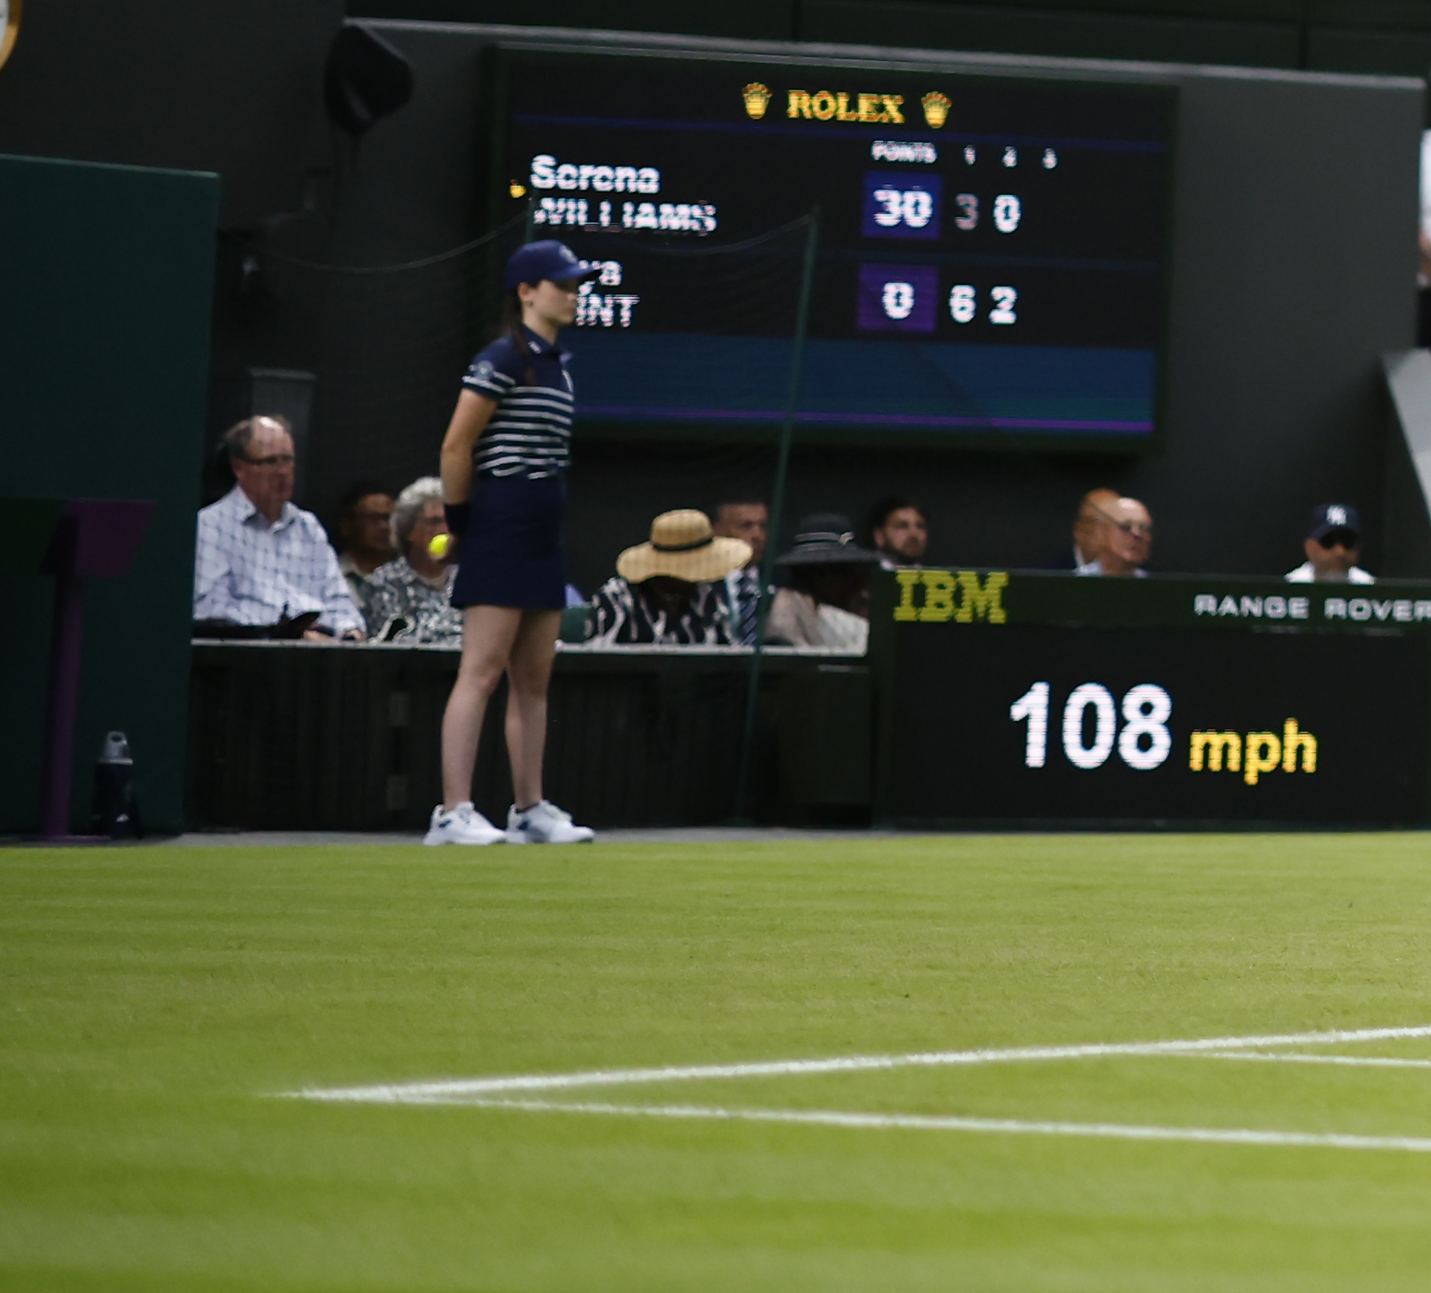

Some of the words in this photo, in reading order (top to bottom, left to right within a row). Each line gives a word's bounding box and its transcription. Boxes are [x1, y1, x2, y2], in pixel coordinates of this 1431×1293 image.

[787, 90, 905, 124] ROLEX
[872, 140, 937, 164] POINTS
[530, 154, 661, 194] Serena
[533, 197, 717, 236] WILLIAMS
[872, 185, 934, 228] 30
[956, 194, 978, 230] 3
[993, 195, 1021, 234] 0
[881, 281, 915, 319] 0
[948, 285, 977, 324] 6
[988, 287, 1018, 325] 2
[893, 569, 1008, 624] IBM
[1195, 594, 1309, 619] RANGE
[1010, 681, 1173, 770] 108
[1189, 718, 1318, 785] mph
